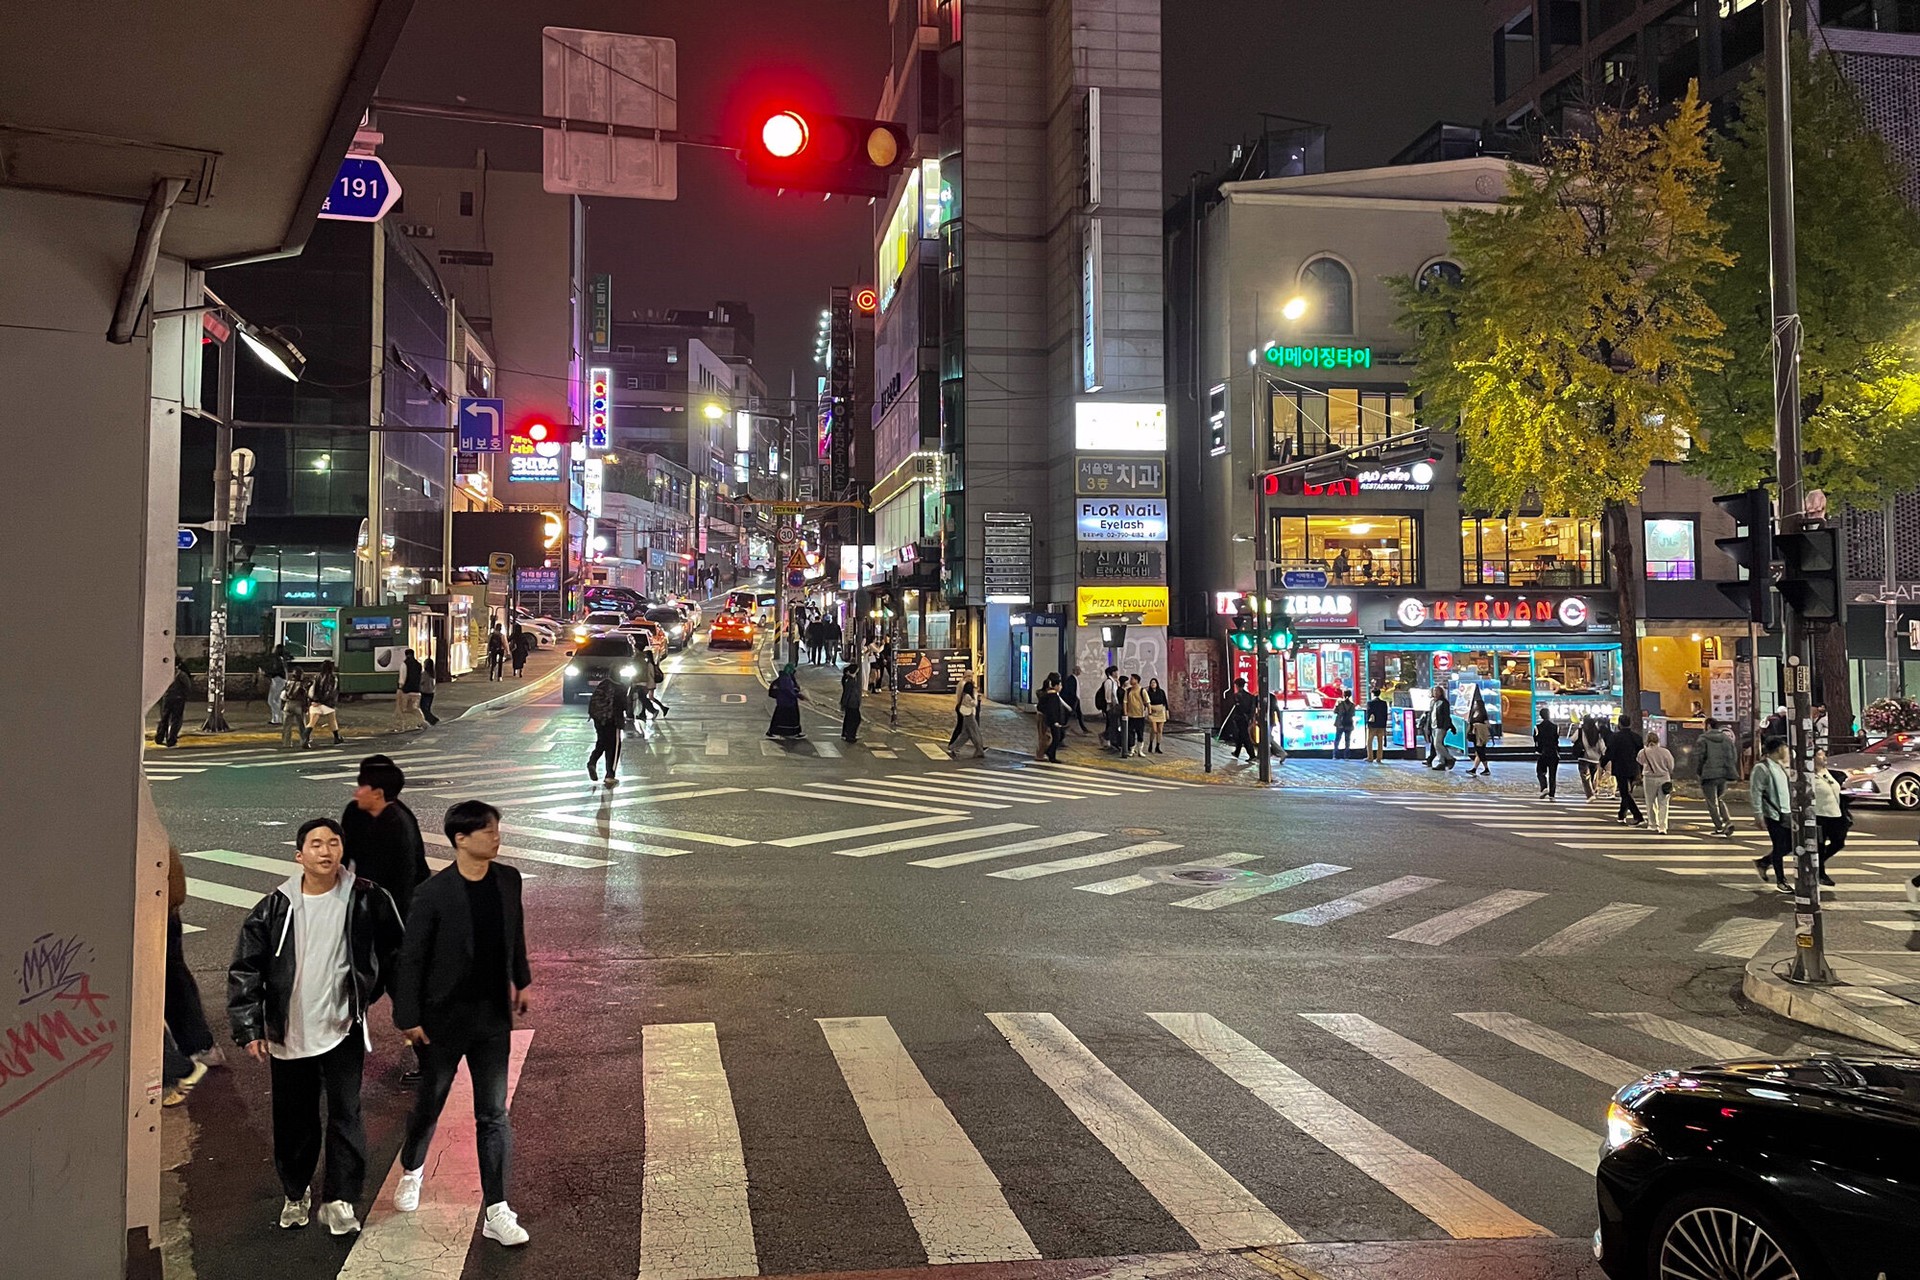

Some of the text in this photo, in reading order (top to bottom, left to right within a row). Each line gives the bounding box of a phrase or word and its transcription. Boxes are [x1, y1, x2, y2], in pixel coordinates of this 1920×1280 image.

[341, 177, 378, 199] 191
[1266, 346, 1371, 369] 어메이징타이
[462, 436, 502, 451] 비보호
[1081, 463, 1161, 489] 서울앤 치과
[1087, 477, 1109, 490] 3층
[1100, 520, 1144, 530] Eyelash
[781, 531, 792, 539] 30
[1092, 599, 1166, 608] PIZZA REVOLUTION
[1433, 601, 1552, 620] KERVAN
[1045, 617, 1057, 625] IBK
